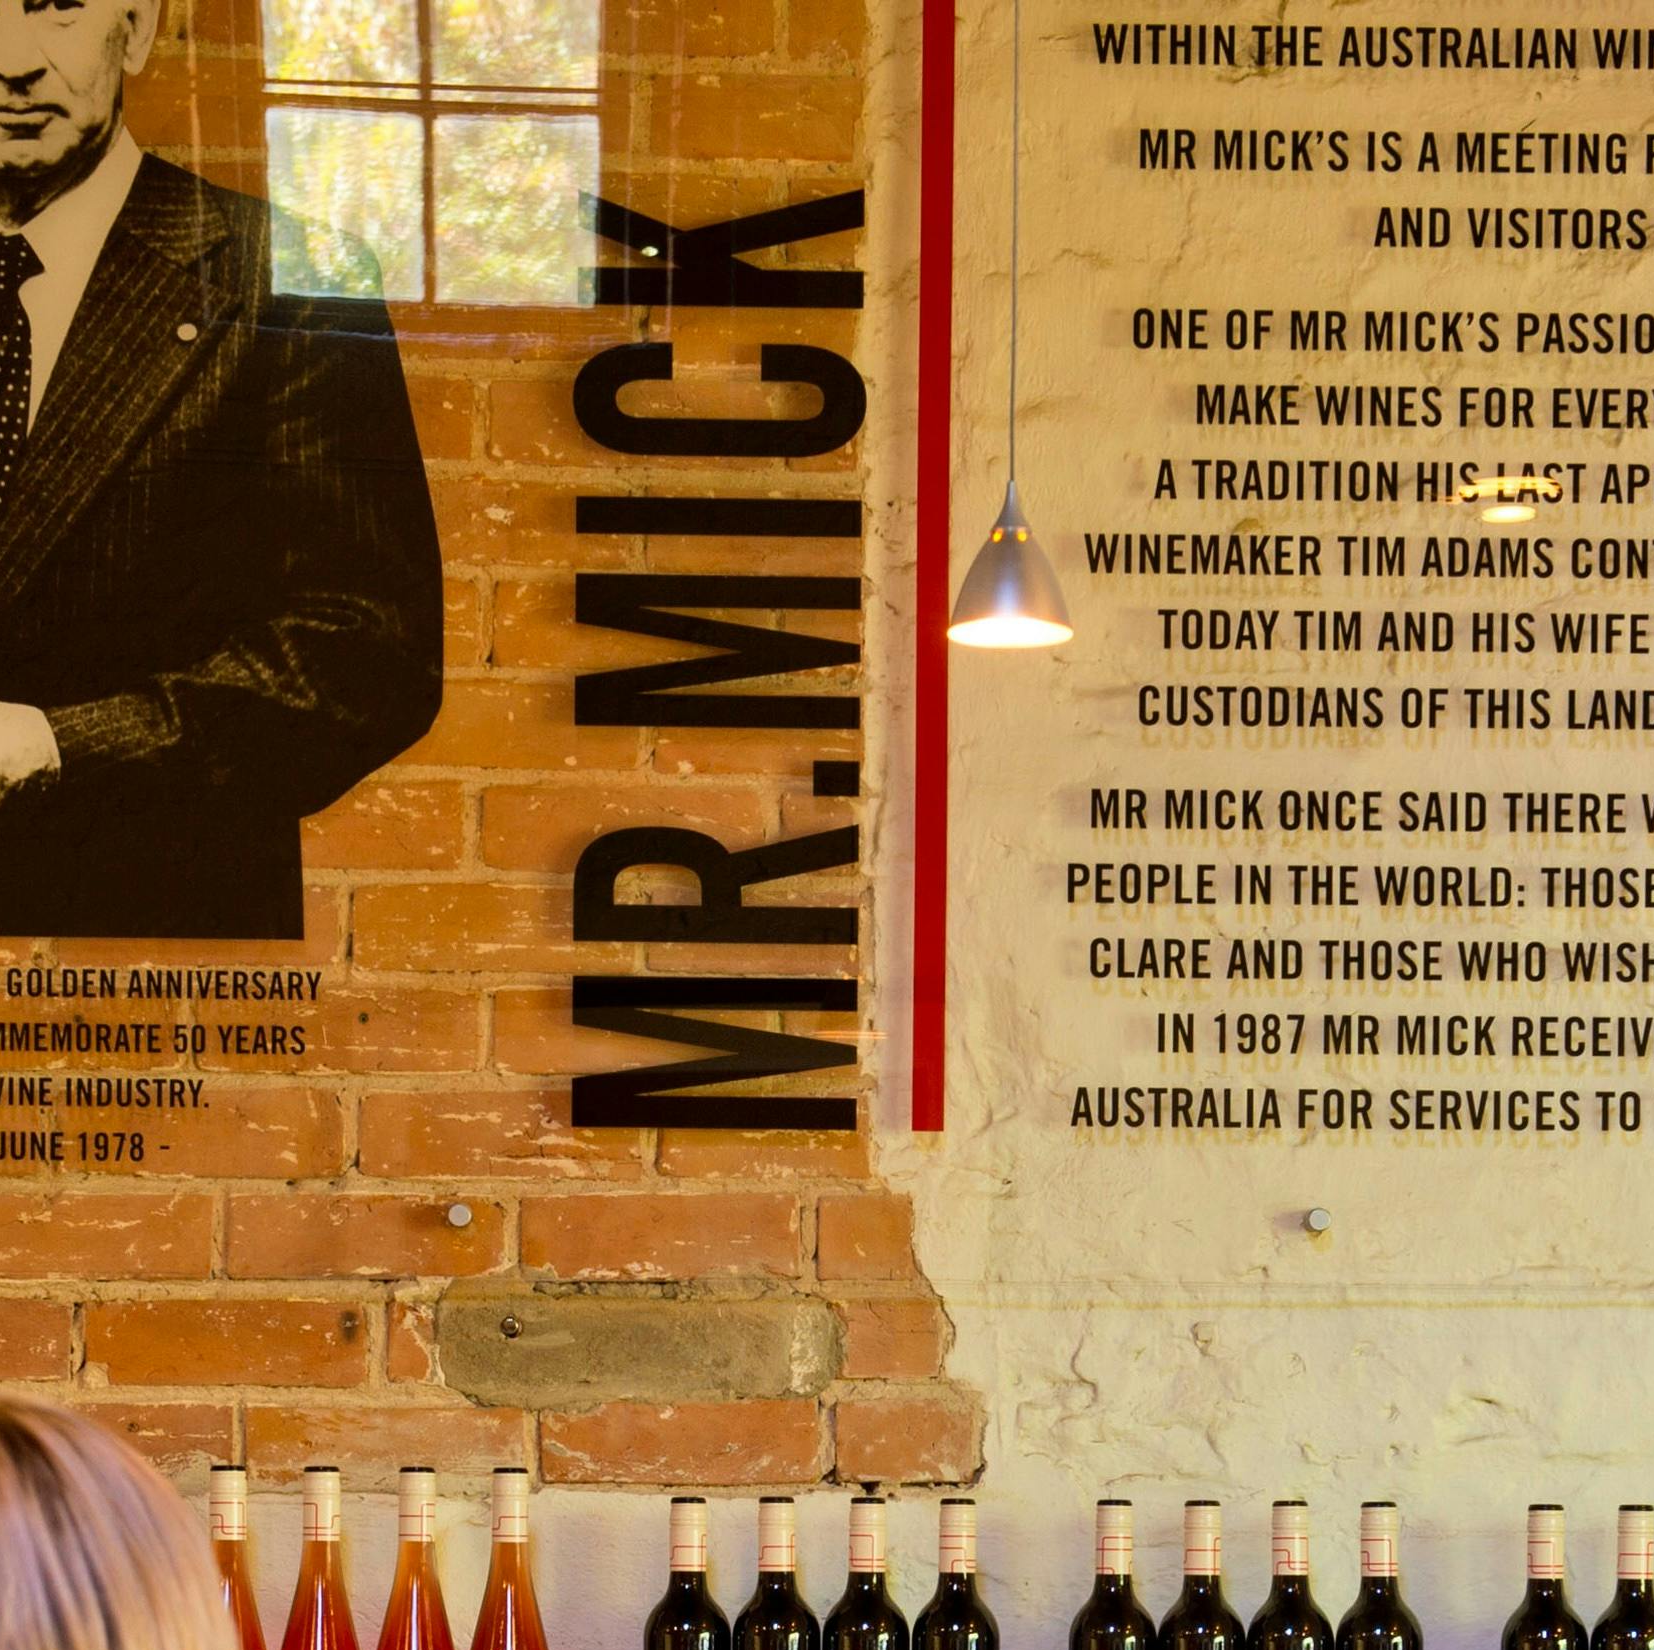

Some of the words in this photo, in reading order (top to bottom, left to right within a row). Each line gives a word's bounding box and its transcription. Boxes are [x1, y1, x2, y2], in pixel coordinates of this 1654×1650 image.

[1092, 23, 1239, 68] WITHIN
[1250, 24, 1323, 68] THE
[1338, 26, 1577, 70] AUSTRALIAN
[1139, 128, 1197, 170] MR
[1213, 129, 1349, 172] MICK'S
[1367, 130, 1403, 173] IS
[1417, 131, 1441, 173] A
[1456, 131, 1627, 175] MEETING
[1373, 206, 1451, 248] AND
[1467, 207, 1648, 251] VISITORS
[1132, 307, 1209, 350] ONE
[1225, 308, 1274, 351] OF
[1290, 310, 1347, 351] MR
[1364, 311, 1500, 353] MICK'S
[1196, 384, 1300, 426] MAKE
[1314, 385, 1442, 428] WINES
[1459, 386, 1535, 429] FOR
[1153, 458, 1177, 500] A
[1191, 459, 1399, 502] TRADITION
[1416, 461, 1480, 503] HIS
[1497, 462, 1587, 504] LAST
[1084, 533, 1321, 576] WINEMAKER
[1337, 535, 1405, 577] TIM
[1420, 536, 1554, 579] ADAMS
[1157, 608, 1280, 651] TODAY
[1293, 610, 1362, 652] TIM
[1377, 611, 1454, 653] AND
[1472, 612, 1536, 654] HIS
[1550, 613, 1650, 654] WIFE
[1138, 684, 1384, 729] CUSTODIANS
[1401, 687, 1449, 729] OF
[1463, 688, 1551, 730] THIS
[1090, 788, 1147, 830] MR
[1164, 789, 1264, 831] MICK
[1278, 790, 1383, 832] ONCE
[1398, 791, 1487, 833] SAID
[1502, 792, 1627, 834] THERE
[1067, 862, 1217, 905] PEOPLE
[1234, 864, 1272, 905] IN
[1287, 865, 1359, 906] THE
[1374, 865, 1525, 907] WORLD:
[1089, 937, 1211, 979] CLARE
[1226, 939, 1303, 980] AND
[1319, 940, 1443, 981] THOSE
[1457, 941, 1547, 982] WHO
[6, 968, 116, 999] GOLDEN
[127, 969, 321, 1001] ANNIVERSARY
[173, 1023, 206, 1054] 50
[217, 1025, 306, 1055] YEARS
[1157, 1013, 1194, 1054] IN
[1214, 1013, 1305, 1055] 1987
[1323, 1014, 1380, 1055] MR
[1397, 1015, 1496, 1056] MICK
[65, 1077, 209, 1108] INDUSTRY.
[1070, 1086, 1281, 1129] AUSTRALIA
[1298, 1088, 1373, 1130] FOR
[1389, 1089, 1580, 1132] SERVICES
[1595, 1091, 1641, 1132] TO
[78, 1131, 144, 1162] 1978
